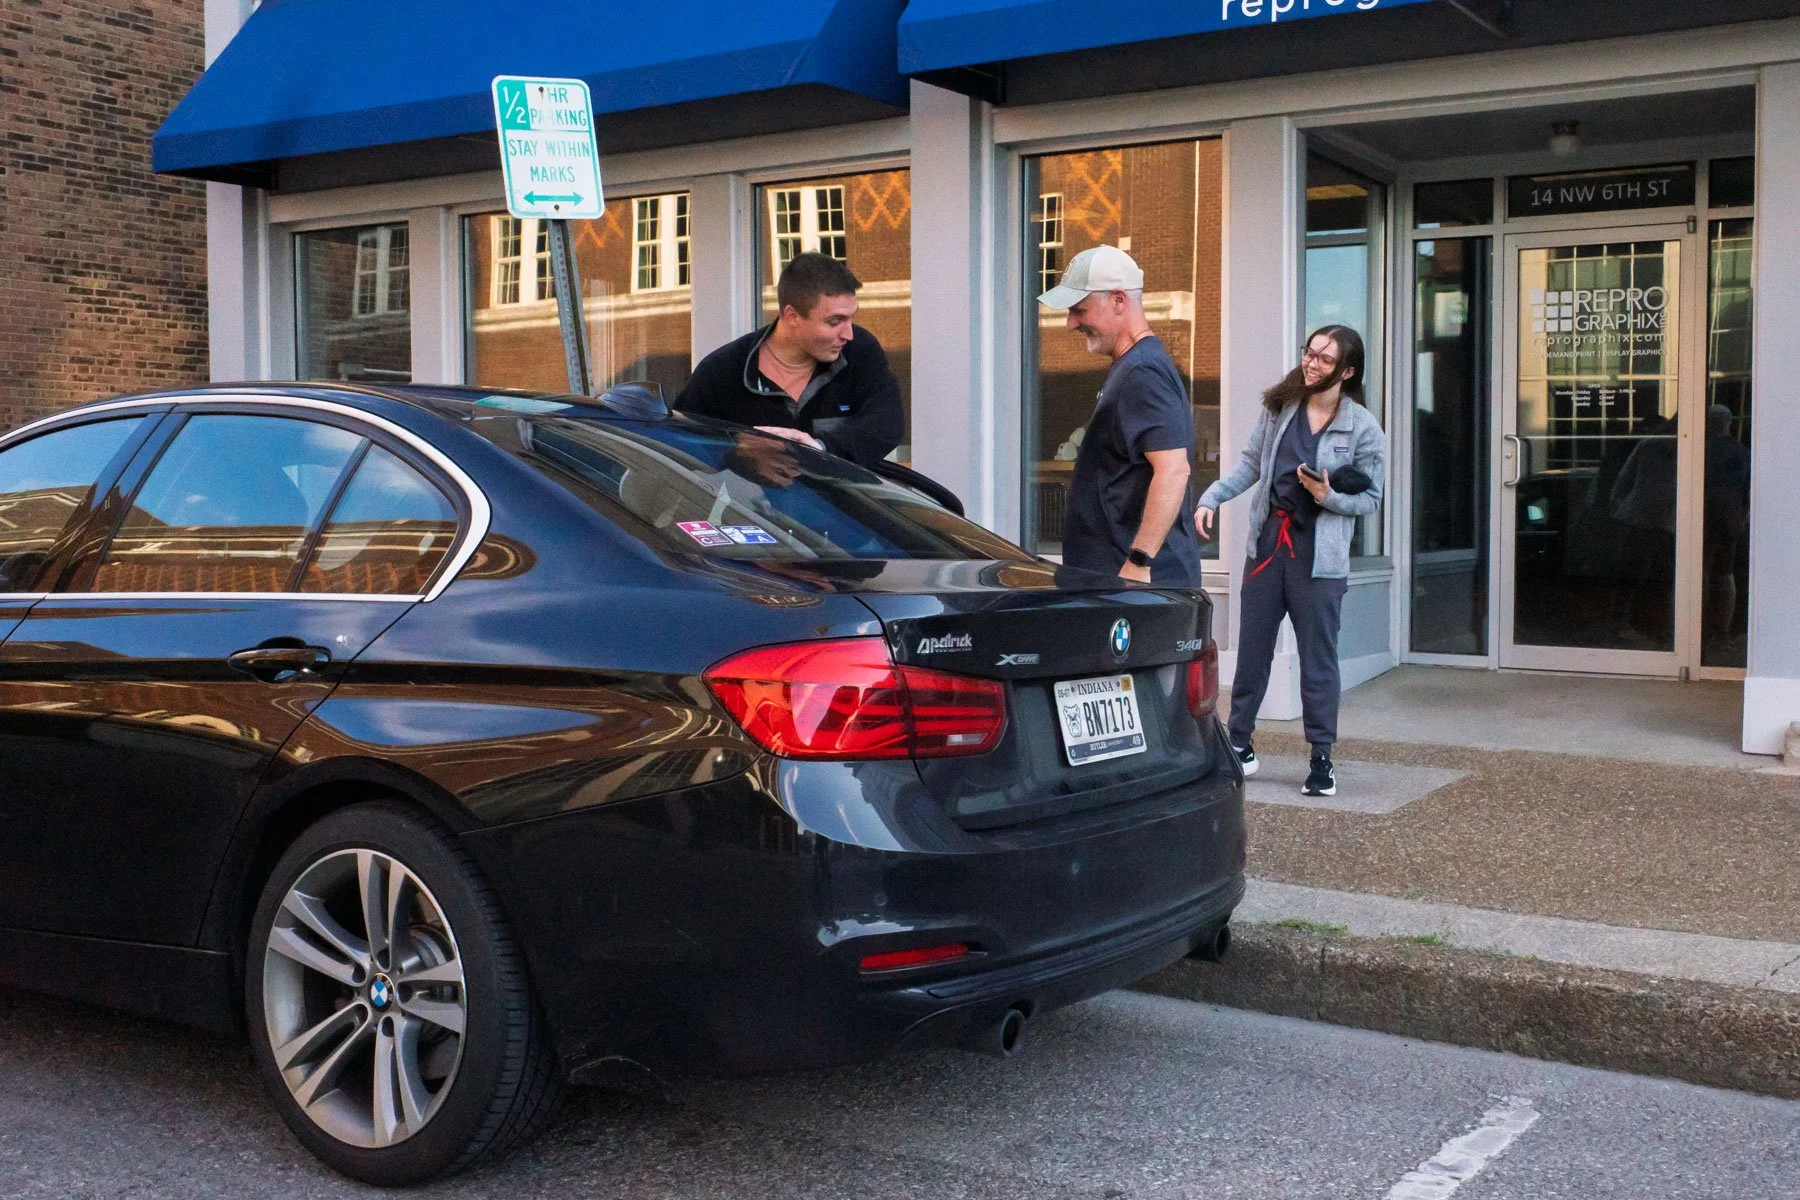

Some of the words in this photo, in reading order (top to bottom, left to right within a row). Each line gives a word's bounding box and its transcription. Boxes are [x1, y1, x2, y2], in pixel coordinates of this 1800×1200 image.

[1222, 0, 1379, 22] rep
[546, 87, 569, 103] HR
[508, 139, 538, 156] STAY
[545, 141, 591, 157] WITHIN
[530, 166, 576, 183] MARKS
[1531, 188, 1553, 206] 14
[1560, 185, 1596, 203] NW
[1602, 181, 1641, 200] 6TH
[1647, 179, 1671, 197] ST
[1573, 286, 1668, 313] REPRO
[1575, 312, 1660, 331] GRAPHIX
[1077, 681, 1114, 695] INDIANA
[1083, 696, 1135, 737] BN7173
